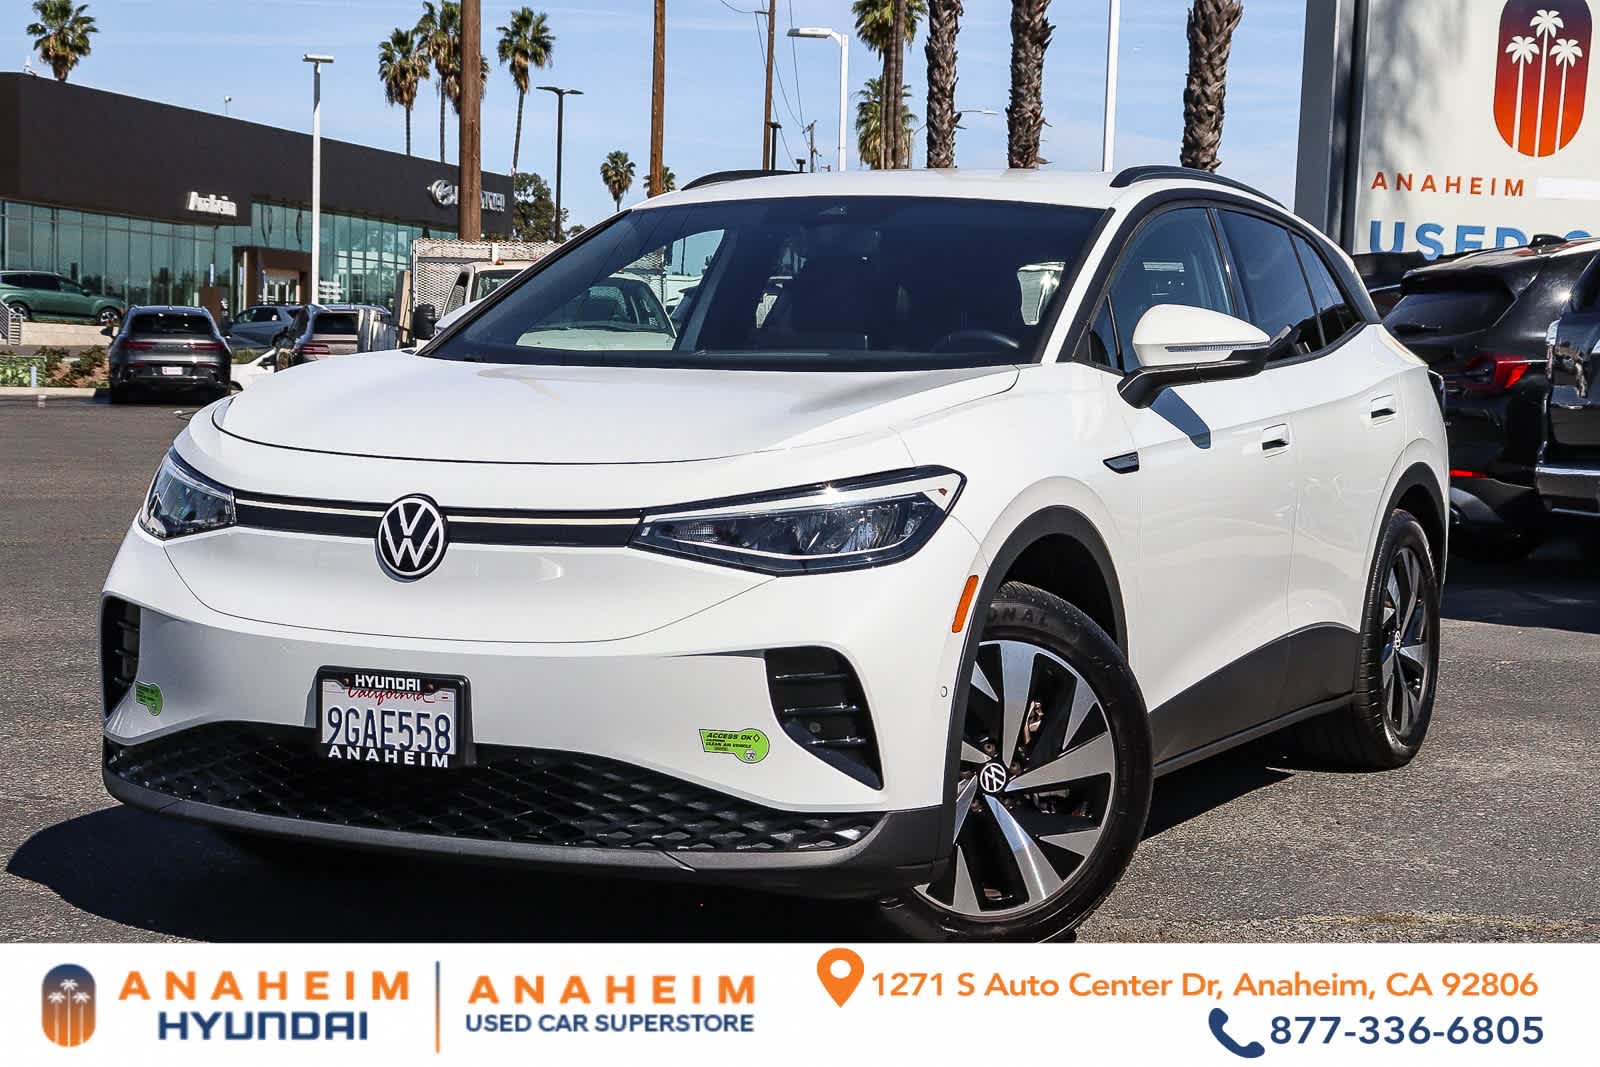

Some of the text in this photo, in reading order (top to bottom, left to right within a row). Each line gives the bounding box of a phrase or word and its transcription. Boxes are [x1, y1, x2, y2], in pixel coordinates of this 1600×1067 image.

[1371, 171, 1525, 197] ANAHEIM
[355, 674, 421, 692] HYUNDAI
[327, 705, 451, 754] 9GAE558
[706, 732, 739, 740] ACCESS
[328, 745, 449, 768] ANAHEIM
